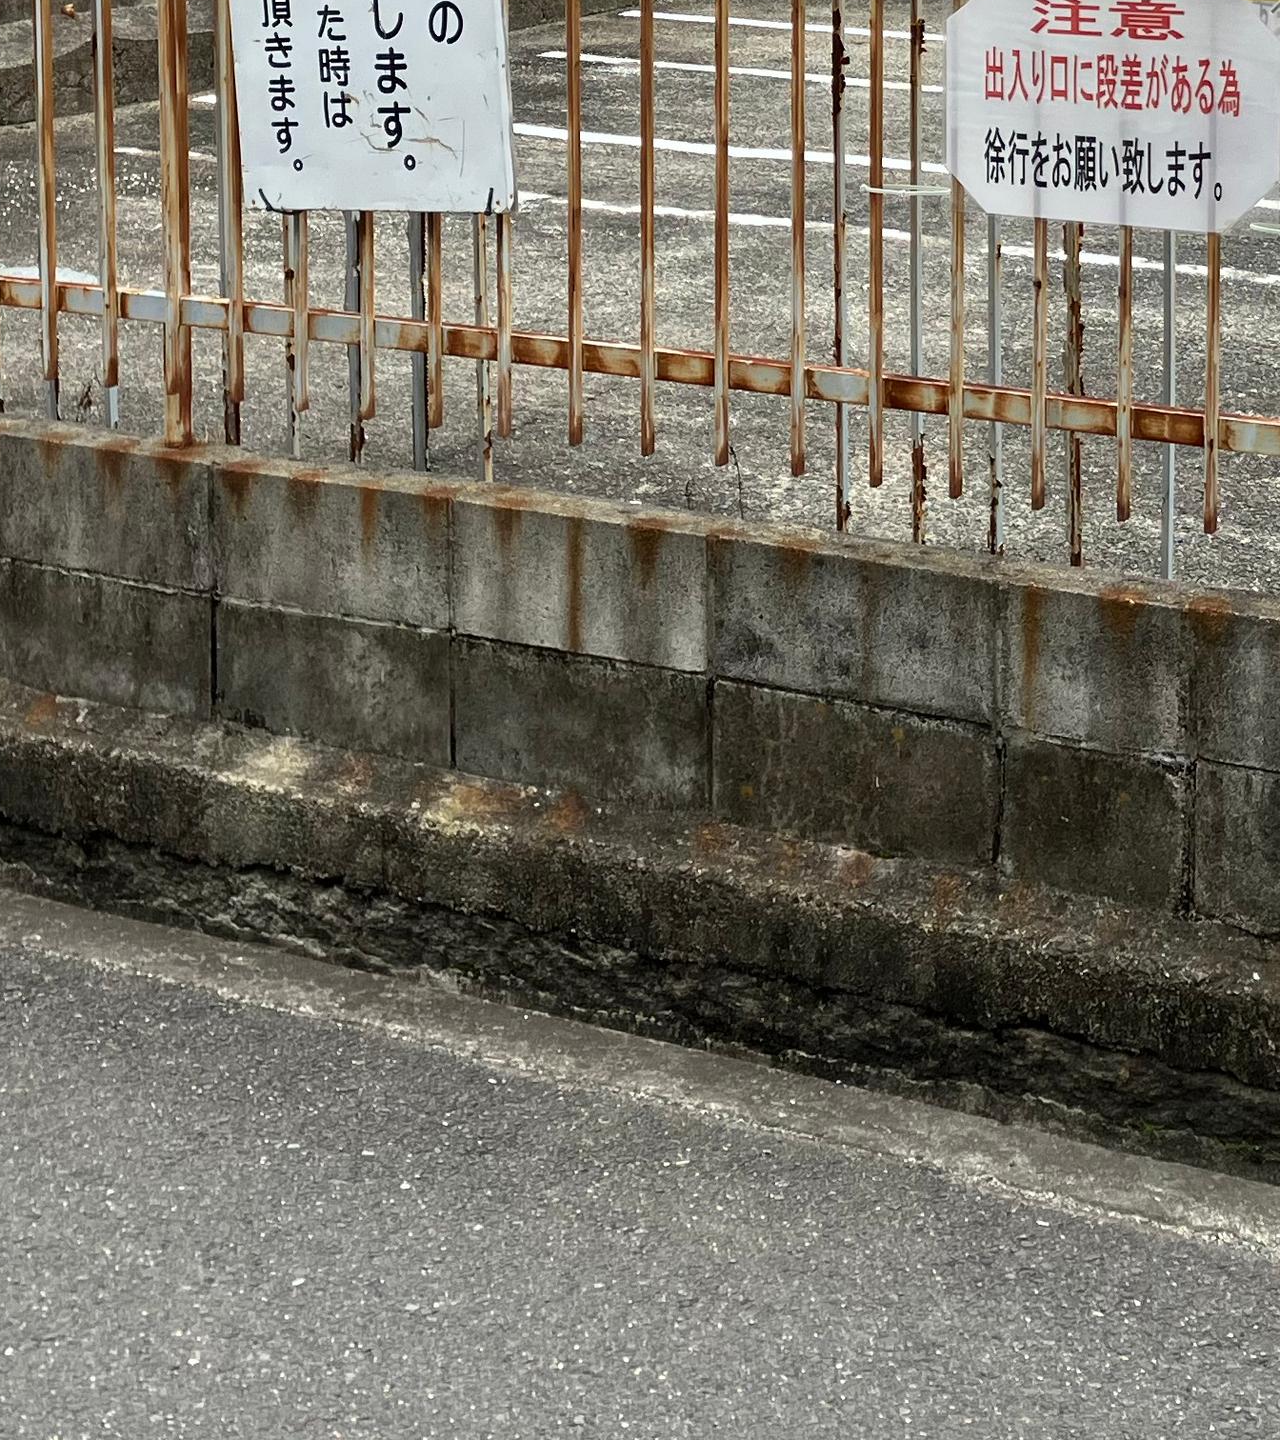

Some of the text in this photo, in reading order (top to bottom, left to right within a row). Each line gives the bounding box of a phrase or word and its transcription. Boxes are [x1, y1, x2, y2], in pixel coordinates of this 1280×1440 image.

[983, 46, 1241, 118] 出入り口に段差がある為
[983, 126, 1223, 203] 徐行をお願い致します。
